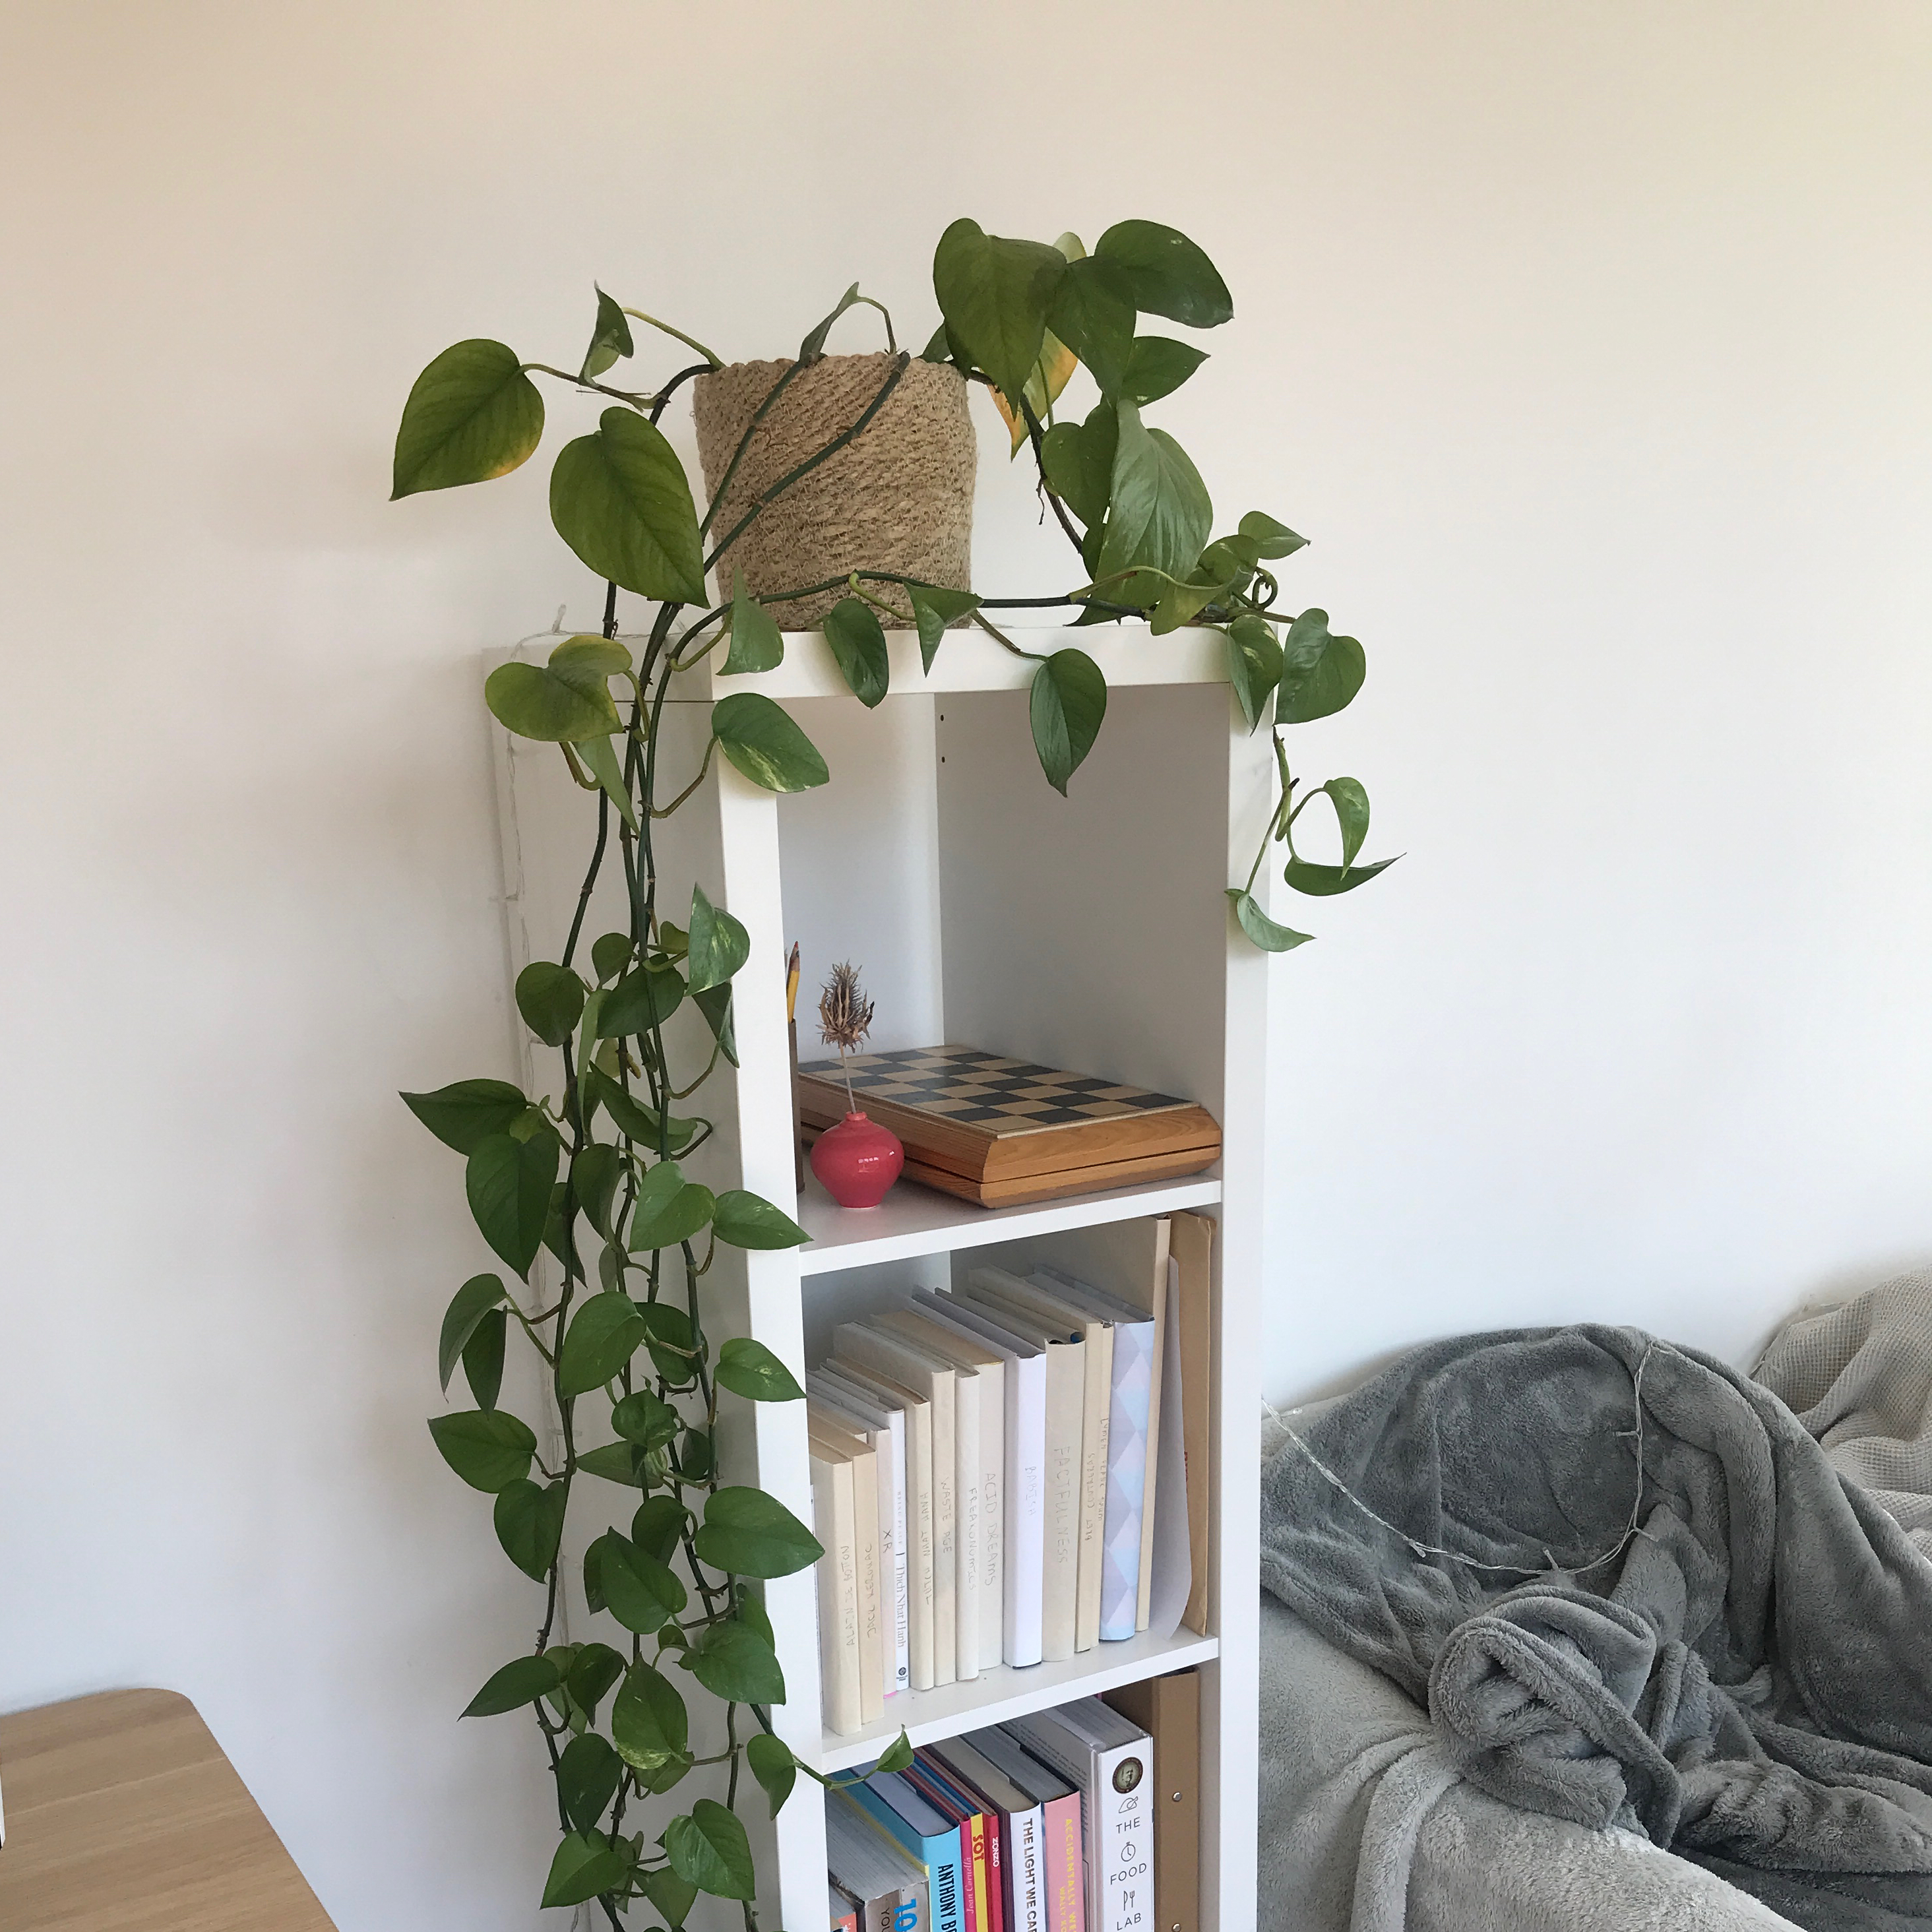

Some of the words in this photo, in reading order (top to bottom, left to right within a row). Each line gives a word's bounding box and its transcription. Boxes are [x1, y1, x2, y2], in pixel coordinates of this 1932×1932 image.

[941, 1477, 951, 1521] WASTE
[985, 1473, 997, 1514] ACID
[1024, 1466, 1037, 1516] BABISH
[1054, 1446, 1071, 1563] FACTFULNESS
[942, 1531, 952, 1553] AGE
[968, 1487, 978, 1590] FREAKONOMICS
[985, 1523, 999, 1586] DREAMS
[896, 1563, 905, 1592] Thich
[867, 1605, 877, 1638] JACK
[896, 1594, 906, 1619] Nhat
[844, 1607, 856, 1646] ALAIN
[897, 1621, 907, 1648] Hanh
[1023, 1818, 1034, 1845] THE
[1116, 1817, 1140, 1834] THE
[972, 1834, 985, 1861] SOT
[1065, 1819, 1076, 1906] ACCIDENTALLY
[1024, 1846, 1036, 1885] LIGHT
[1110, 1863, 1147, 1885] FOOD
[938, 1863, 956, 1918] ANTHONY
[1026, 1887, 1036, 1909] WE
[1069, 1912, 1077, 1932] WE
[1117, 1913, 1141, 1931] LAB
